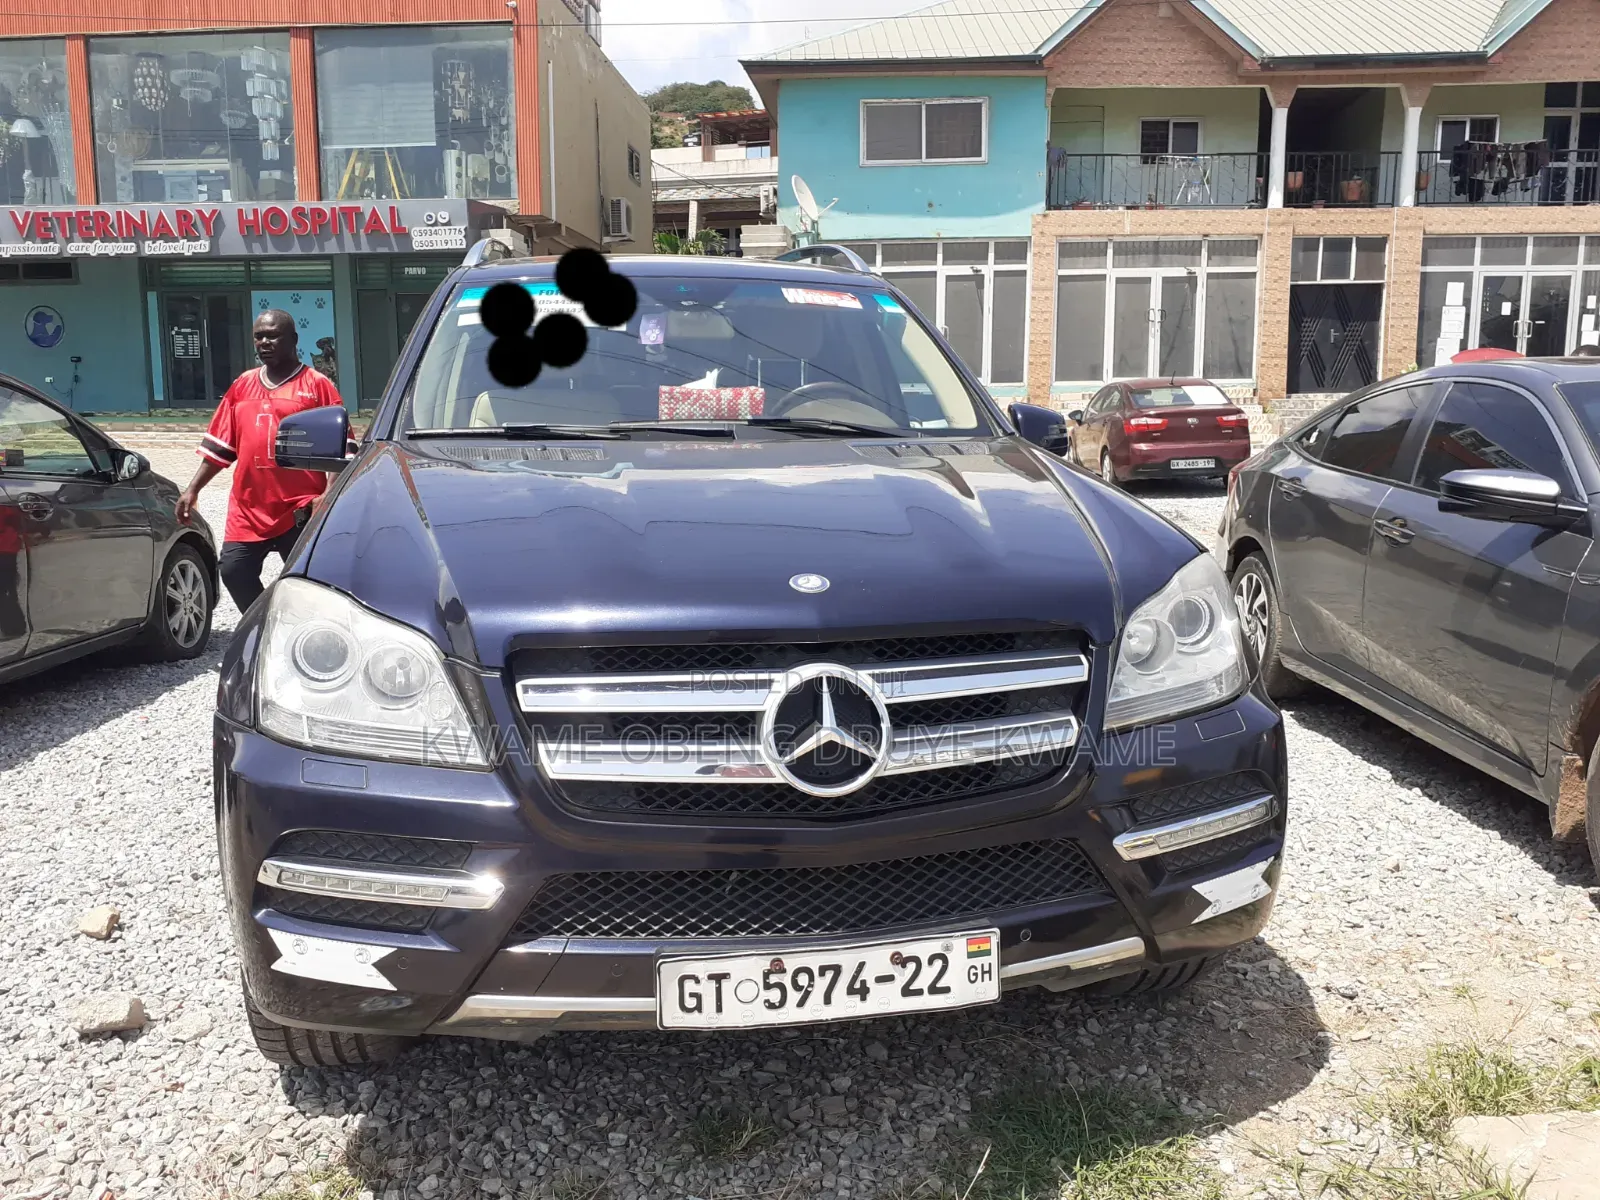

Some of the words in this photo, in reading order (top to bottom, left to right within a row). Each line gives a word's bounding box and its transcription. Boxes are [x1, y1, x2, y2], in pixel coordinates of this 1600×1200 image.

[8, 208, 220, 239] VETERINARY
[237, 205, 409, 236] HOSPITAL
[412, 227, 463, 237] 0593401776
[69, 243, 92, 252] care
[93, 240, 110, 255] for
[111, 243, 135, 255] your
[147, 240, 185, 252] beloved
[187, 240, 208, 255] pets
[413, 238, 464, 248] 0505119112
[404, 266, 427, 275] PARVO
[967, 962, 993, 984] GH
[677, 971, 731, 1014] GT
[762, 951, 952, 1010] 5974-22
